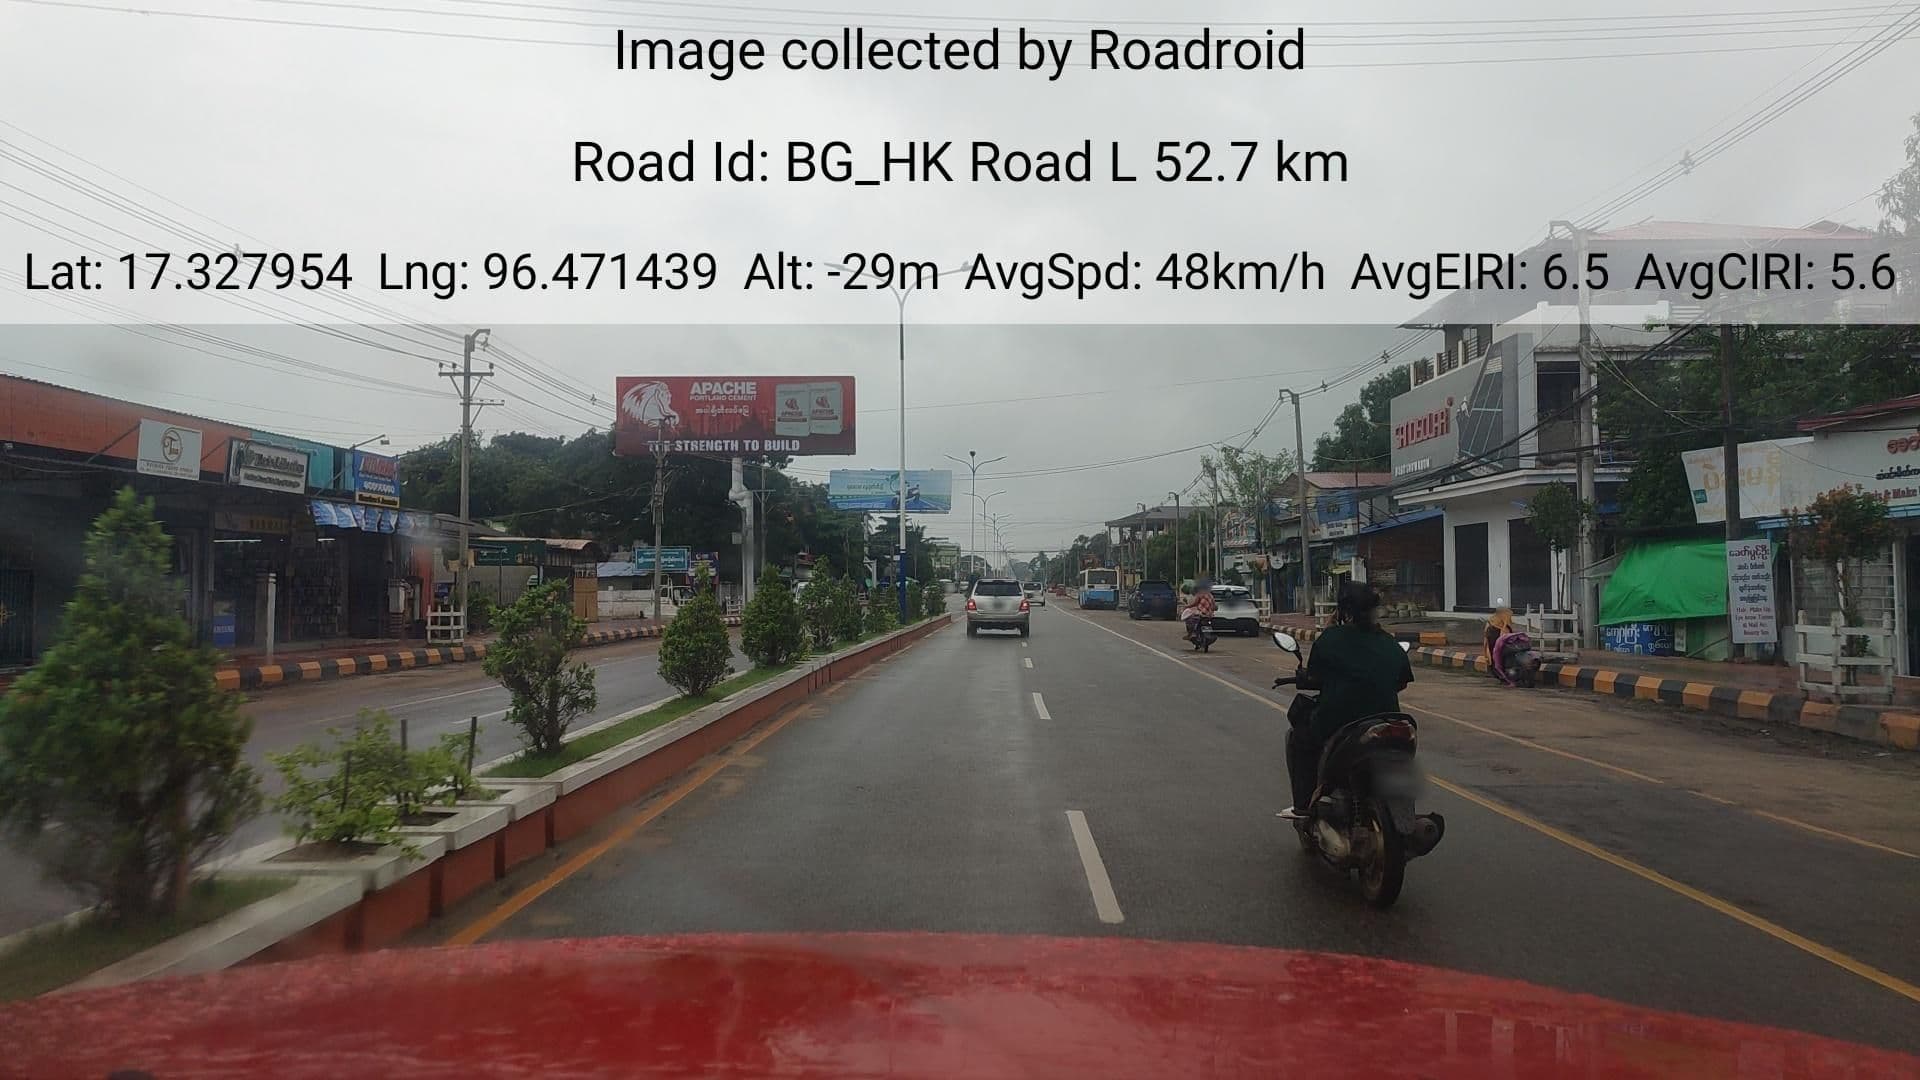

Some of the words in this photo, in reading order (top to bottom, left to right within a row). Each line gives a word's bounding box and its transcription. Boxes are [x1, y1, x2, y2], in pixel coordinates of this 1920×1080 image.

[690, 381, 757, 395] APACHE
[675, 440, 739, 452] STRENGTH
[743, 440, 760, 452] TO
[764, 440, 800, 451] BUILD
[1893, 487, 1917, 499] Make
